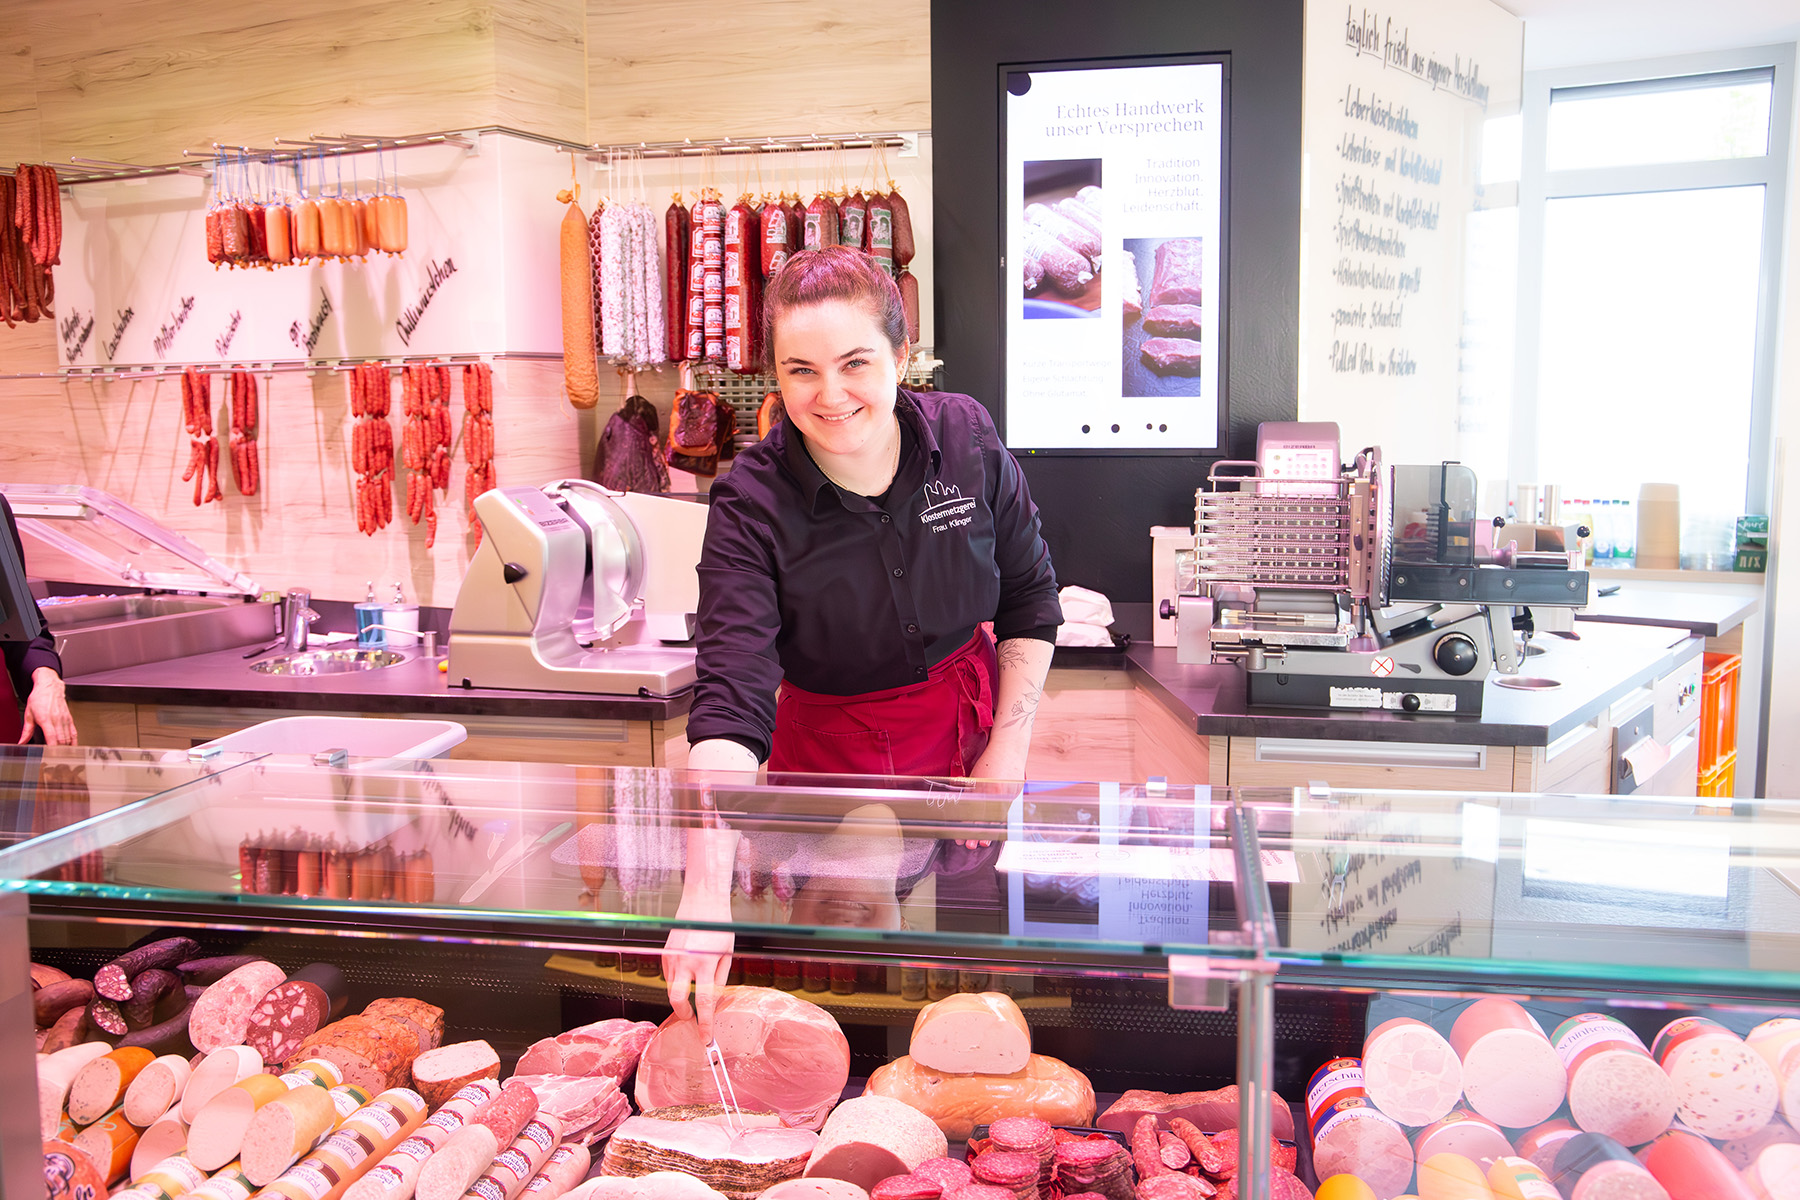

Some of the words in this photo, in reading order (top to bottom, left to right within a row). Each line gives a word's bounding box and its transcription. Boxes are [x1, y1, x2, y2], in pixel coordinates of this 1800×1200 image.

[1346, 4, 1379, 56] täglich
[1384, 17, 1409, 69] frisch
[1412, 53, 1424, 76] aus
[1057, 104, 1110, 119] Echtes
[1116, 99, 1204, 116] Handwerk
[1046, 124, 1092, 137] unser
[1097, 117, 1203, 137] Versprechen
[1146, 158, 1200, 169] Tradition
[1135, 173, 1204, 184] Innovation.
[1148, 186, 1204, 197] Herzblut.
[1123, 199, 1204, 213] Leidenschaft.
[1022, 359, 1047, 368] Kurze
[920, 499, 976, 524] Klostermetzgerei
[932, 524, 948, 534] Frau
[949, 516, 973, 528] Klinger
